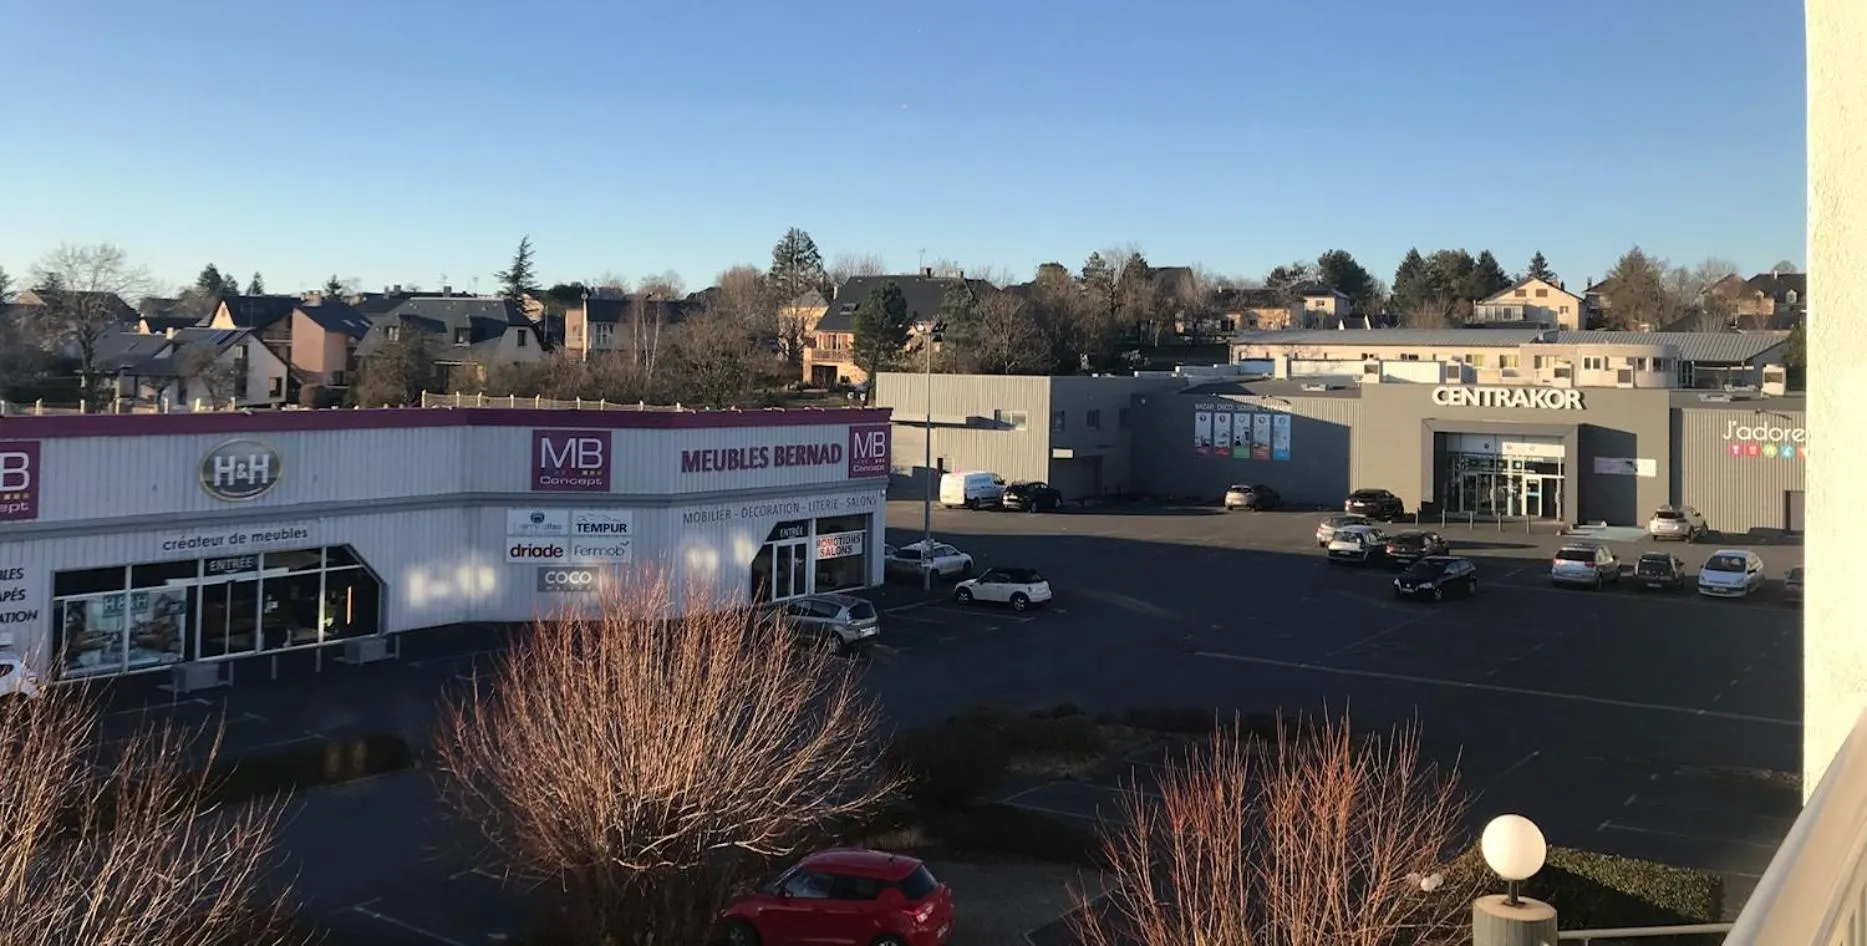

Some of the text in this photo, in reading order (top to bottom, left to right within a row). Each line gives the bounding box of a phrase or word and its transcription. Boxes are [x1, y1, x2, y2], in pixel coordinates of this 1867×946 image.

[1432, 386, 1584, 410] CENTRAKOR
[1723, 420, 1805, 442] J'adore
[541, 437, 603, 469] MB
[854, 431, 886, 459] MB
[681, 443, 843, 473] MEUBLES BERNAD
[213, 453, 270, 487] H&H
[540, 475, 603, 487] Concept
[683, 508, 732, 526] MOBILIER
[846, 496, 877, 507] SALONS
[162, 527, 308, 551] créateur de meubles
[577, 523, 627, 533] TEMPUR
[510, 544, 564, 558] driade
[574, 544, 625, 557] Fermob
[819, 545, 854, 558] SALONS
[545, 571, 592, 584] COCO
